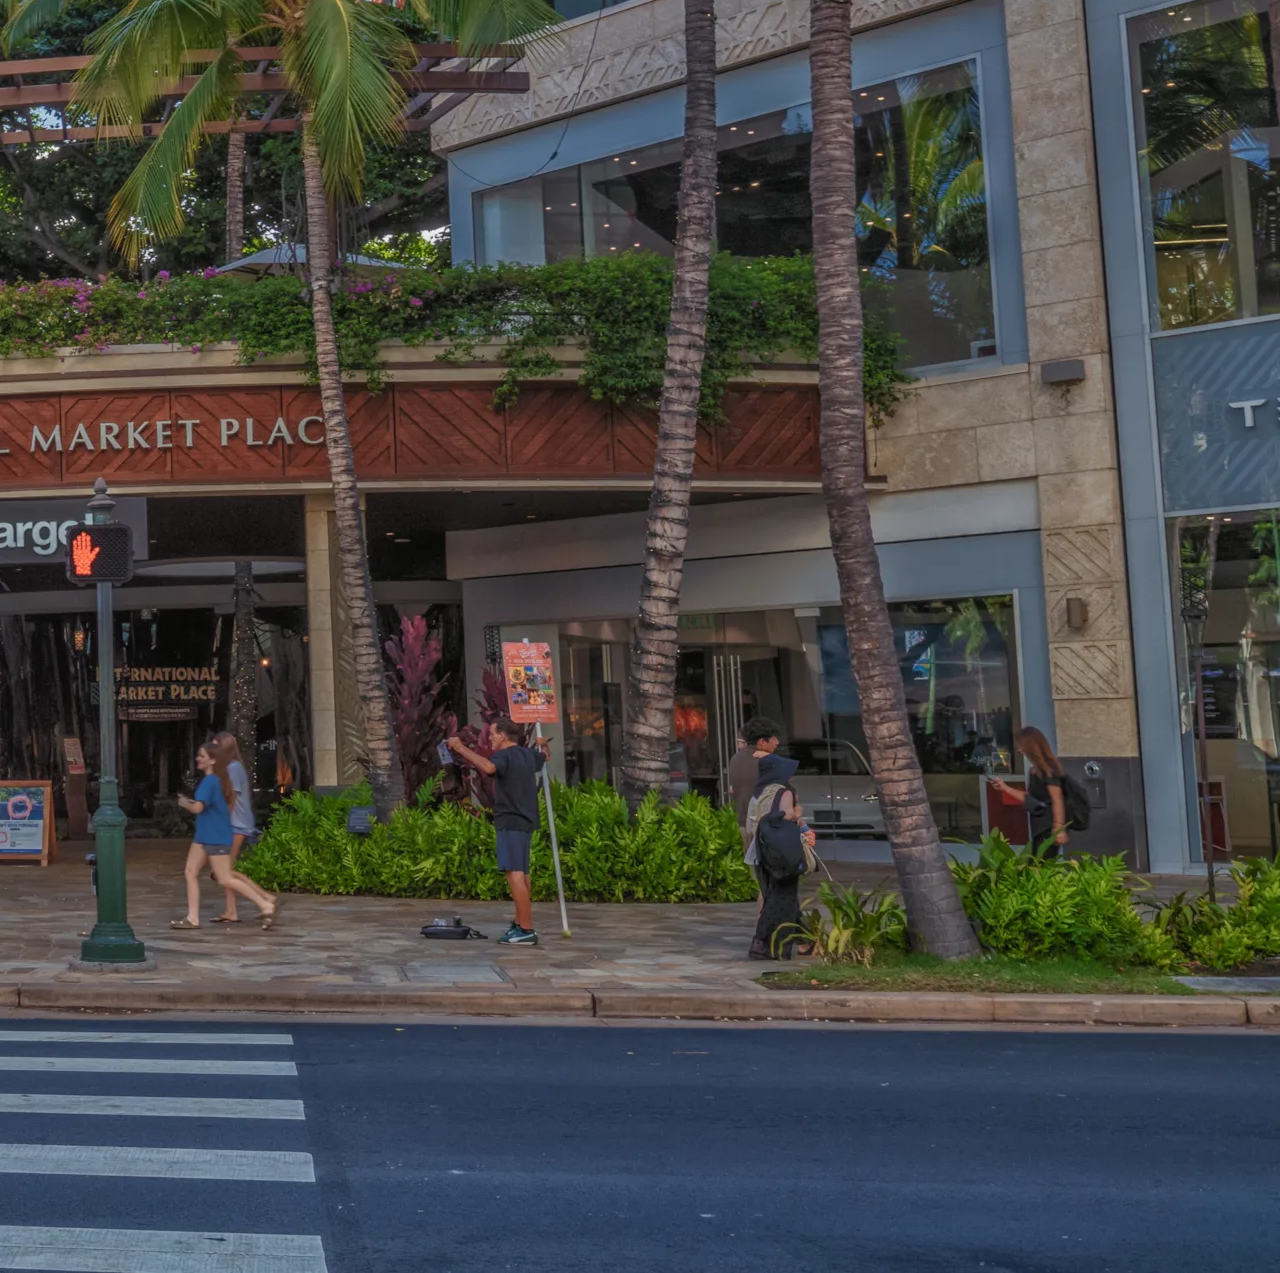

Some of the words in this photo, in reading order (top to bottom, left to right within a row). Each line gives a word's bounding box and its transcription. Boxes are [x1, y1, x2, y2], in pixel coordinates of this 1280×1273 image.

[30, 419, 201, 453] MARKET
[220, 416, 325, 447] PLAC
[113, 685, 165, 701] ARKET
[170, 684, 216, 700] PLACE
